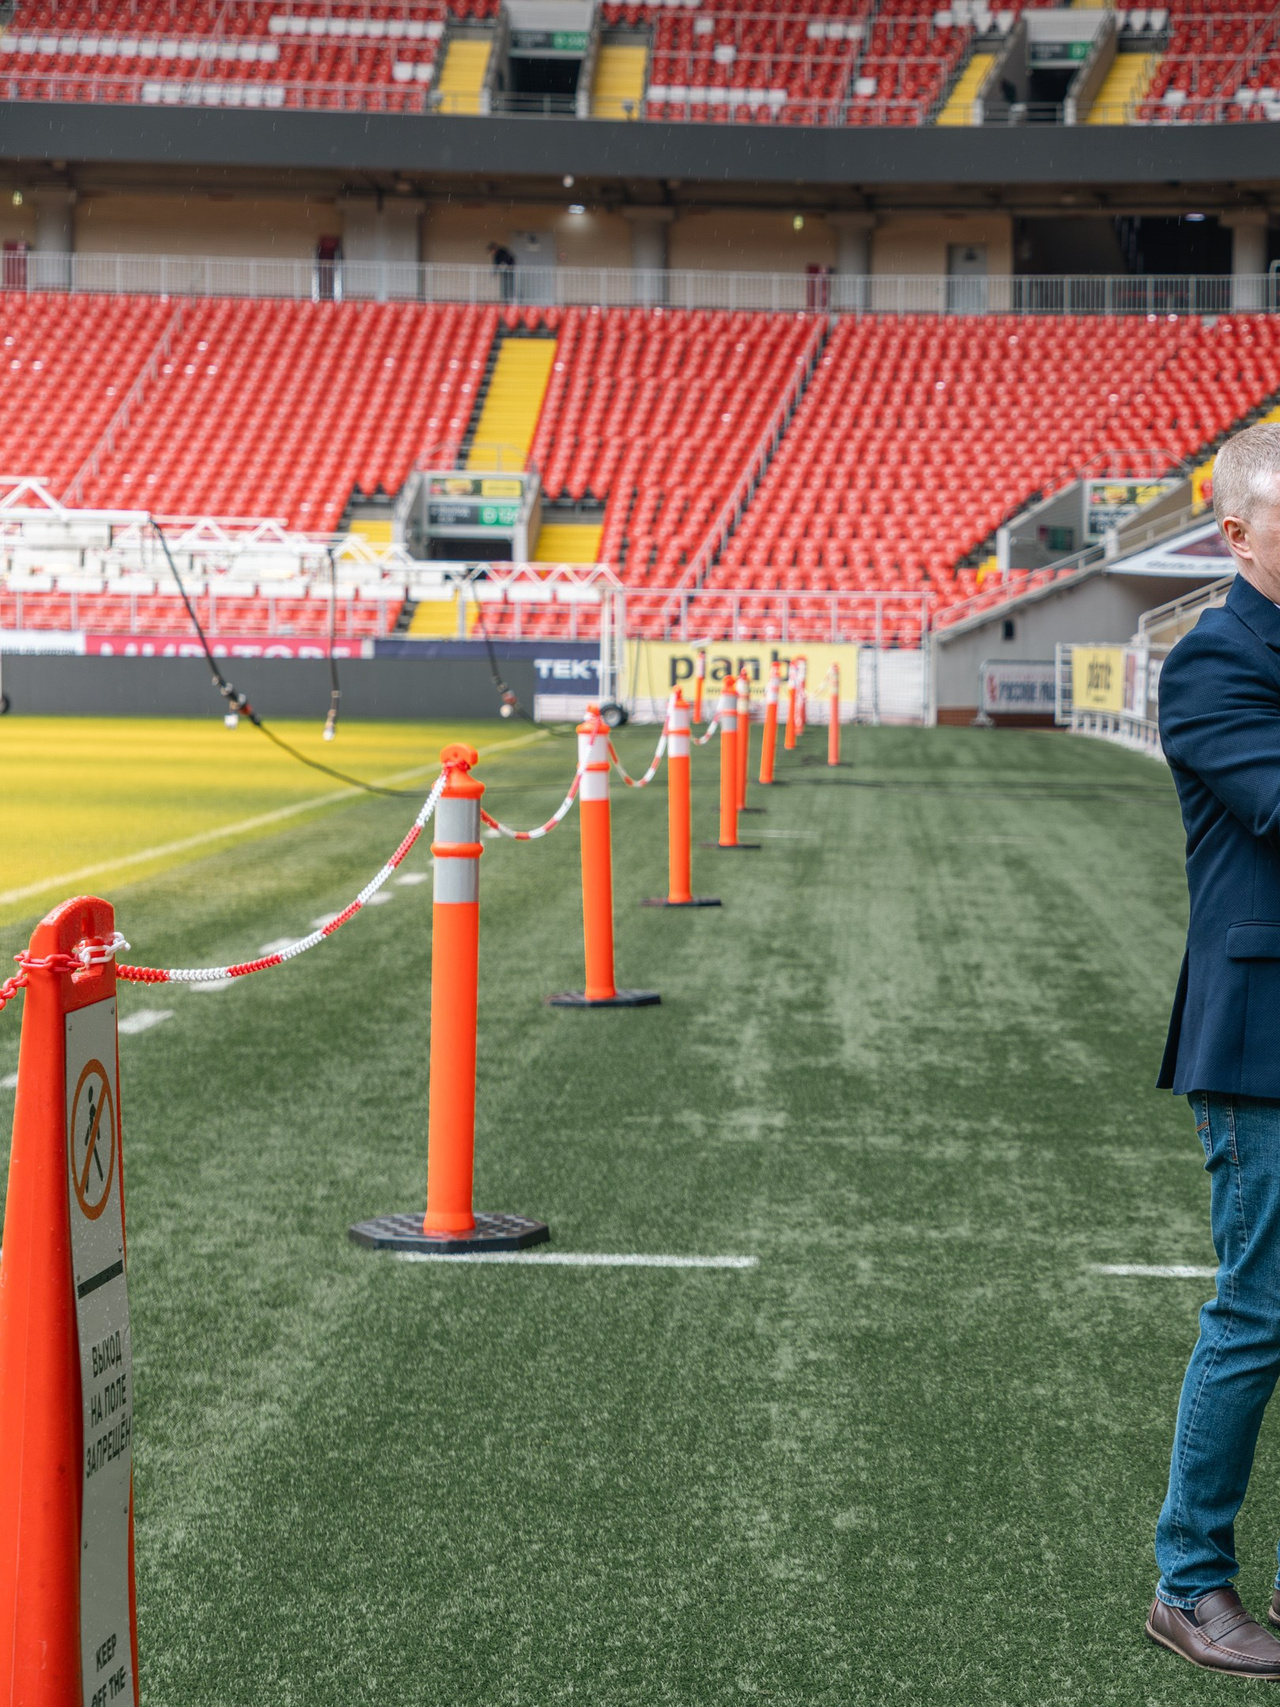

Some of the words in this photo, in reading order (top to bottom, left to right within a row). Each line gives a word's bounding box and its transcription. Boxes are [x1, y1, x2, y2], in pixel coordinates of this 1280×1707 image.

[671, 650, 760, 687] pan
[91, 1329, 123, 1378] ВЫХОД
[90, 1391, 103, 1428] НА
[104, 1373, 127, 1418] ПОЛЕ
[85, 1412, 132, 1479] ЗАПРЕЩЁН
[95, 1633, 117, 1673] KEEP
[91, 1683, 108, 1707] OFF
[108, 1665, 127, 1700] THE
